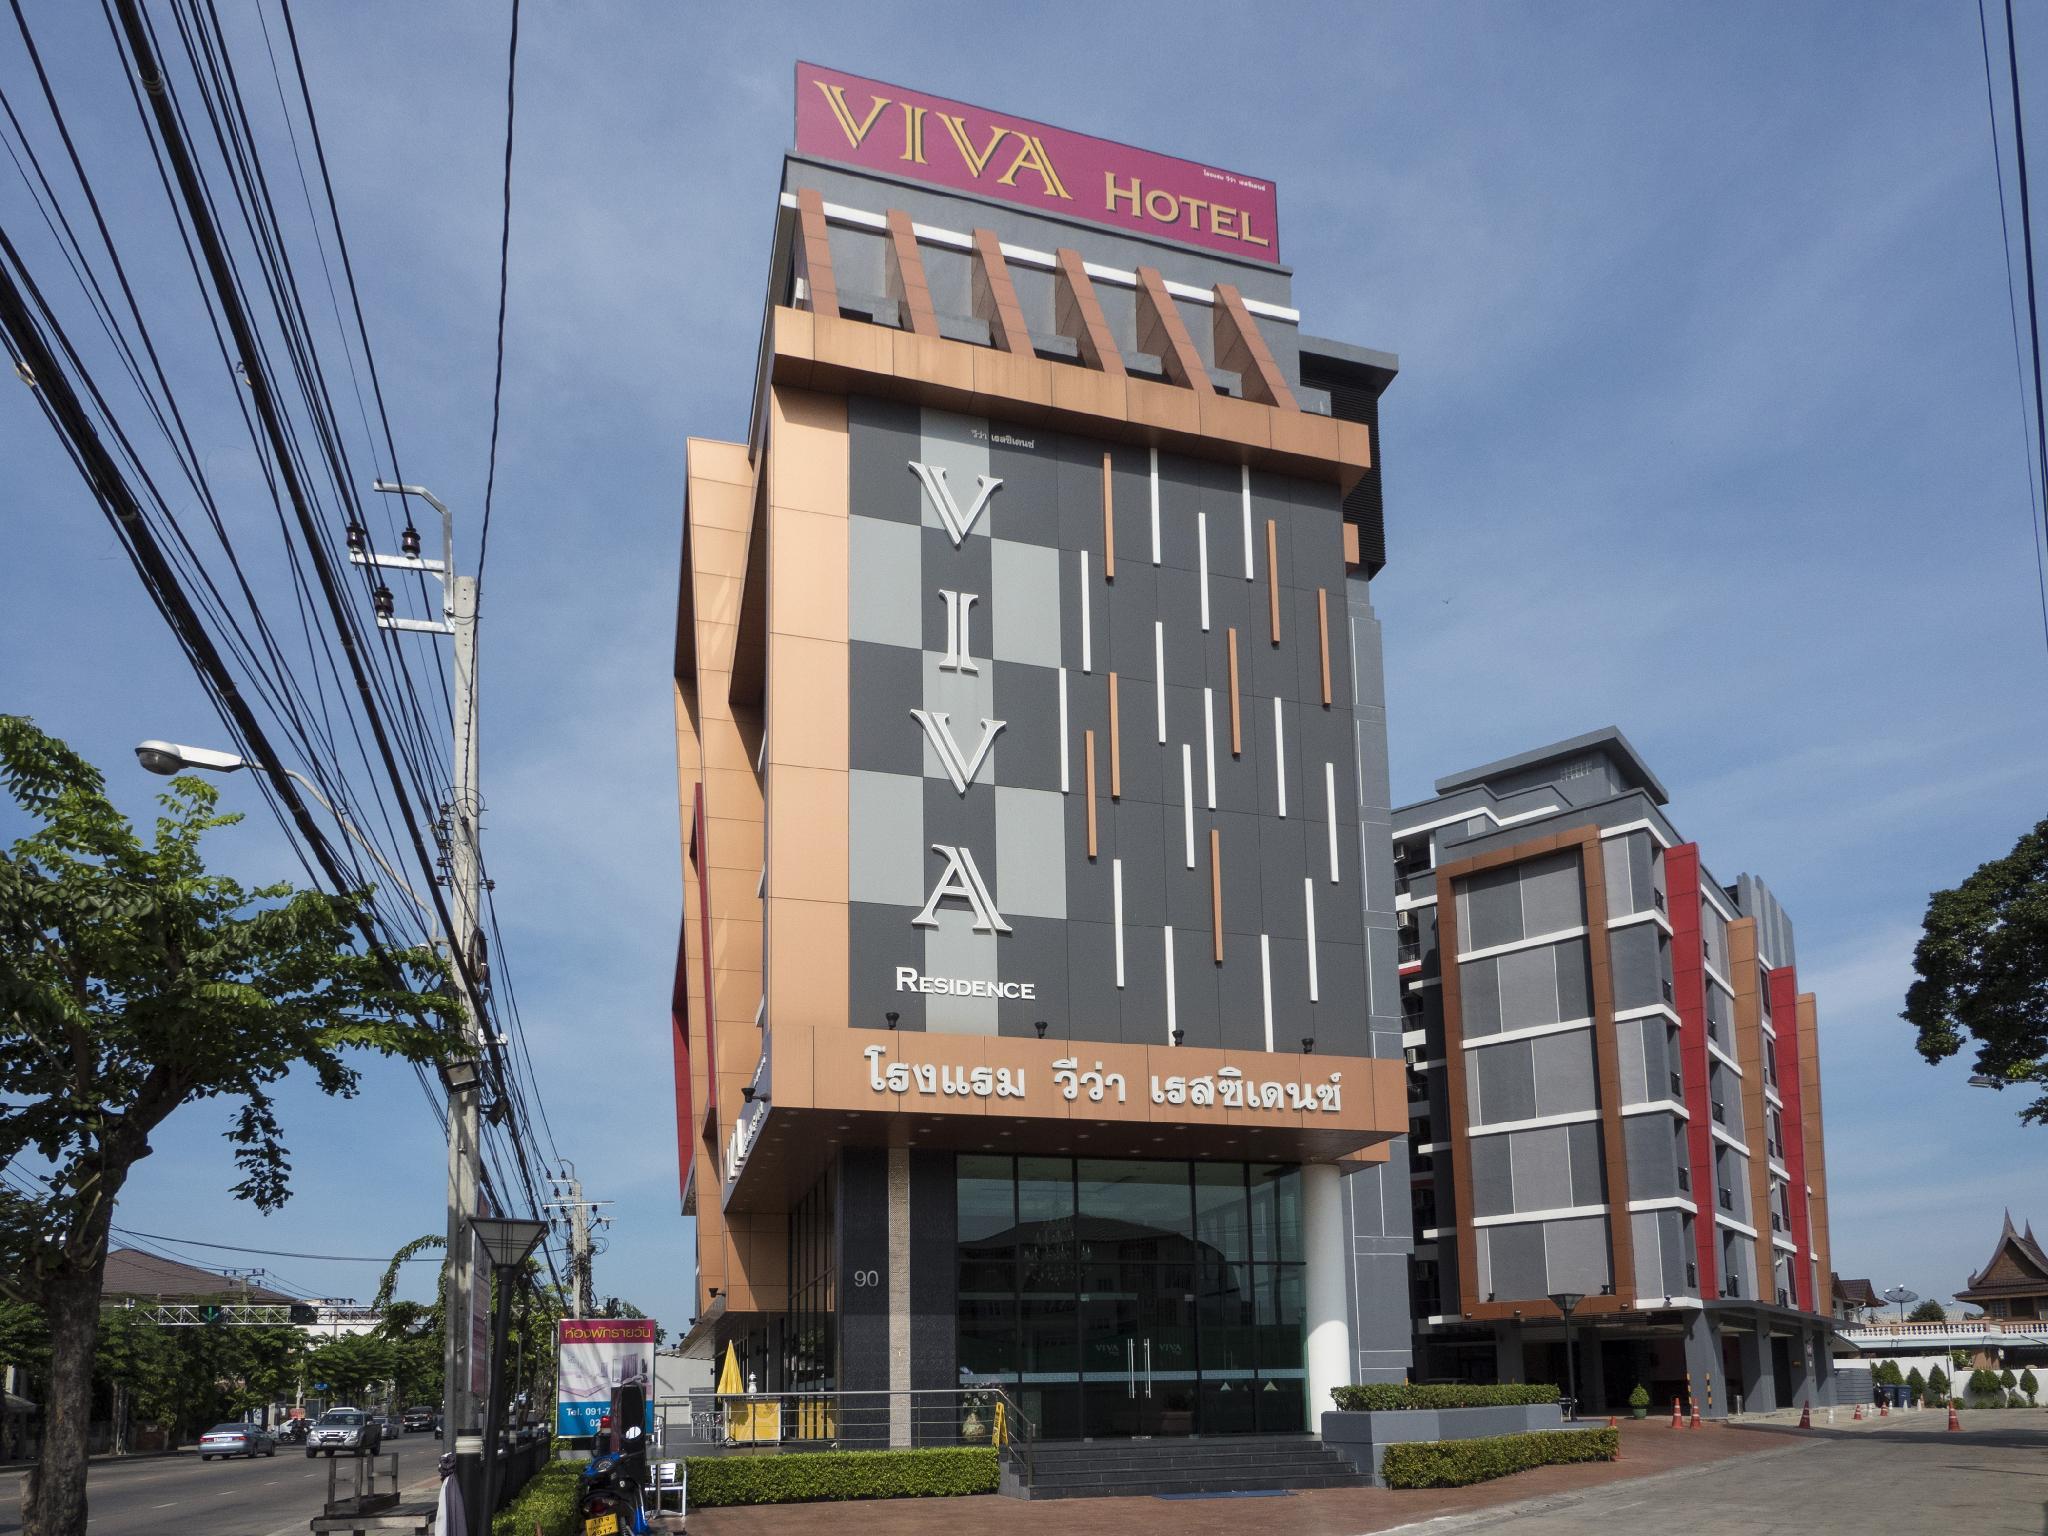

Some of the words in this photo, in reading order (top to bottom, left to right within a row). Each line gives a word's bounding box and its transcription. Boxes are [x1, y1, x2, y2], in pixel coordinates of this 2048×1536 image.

[813, 80, 1073, 200] VIVA
[1104, 171, 1269, 247] HOTEL
[908, 460, 1012, 932] VIVA
[895, 966, 1035, 1000] RESIDENCE
[863, 1044, 1025, 1098] โรงแรม
[1052, 1057, 1126, 1102] วีว่า
[1151, 1066, 1342, 1111] เรสซิเดนซ์
[854, 1270, 879, 1287] 90
[565, 1326, 651, 1339] ห้องพักรายวัน
[566, 1407, 582, 1416] Tel.
